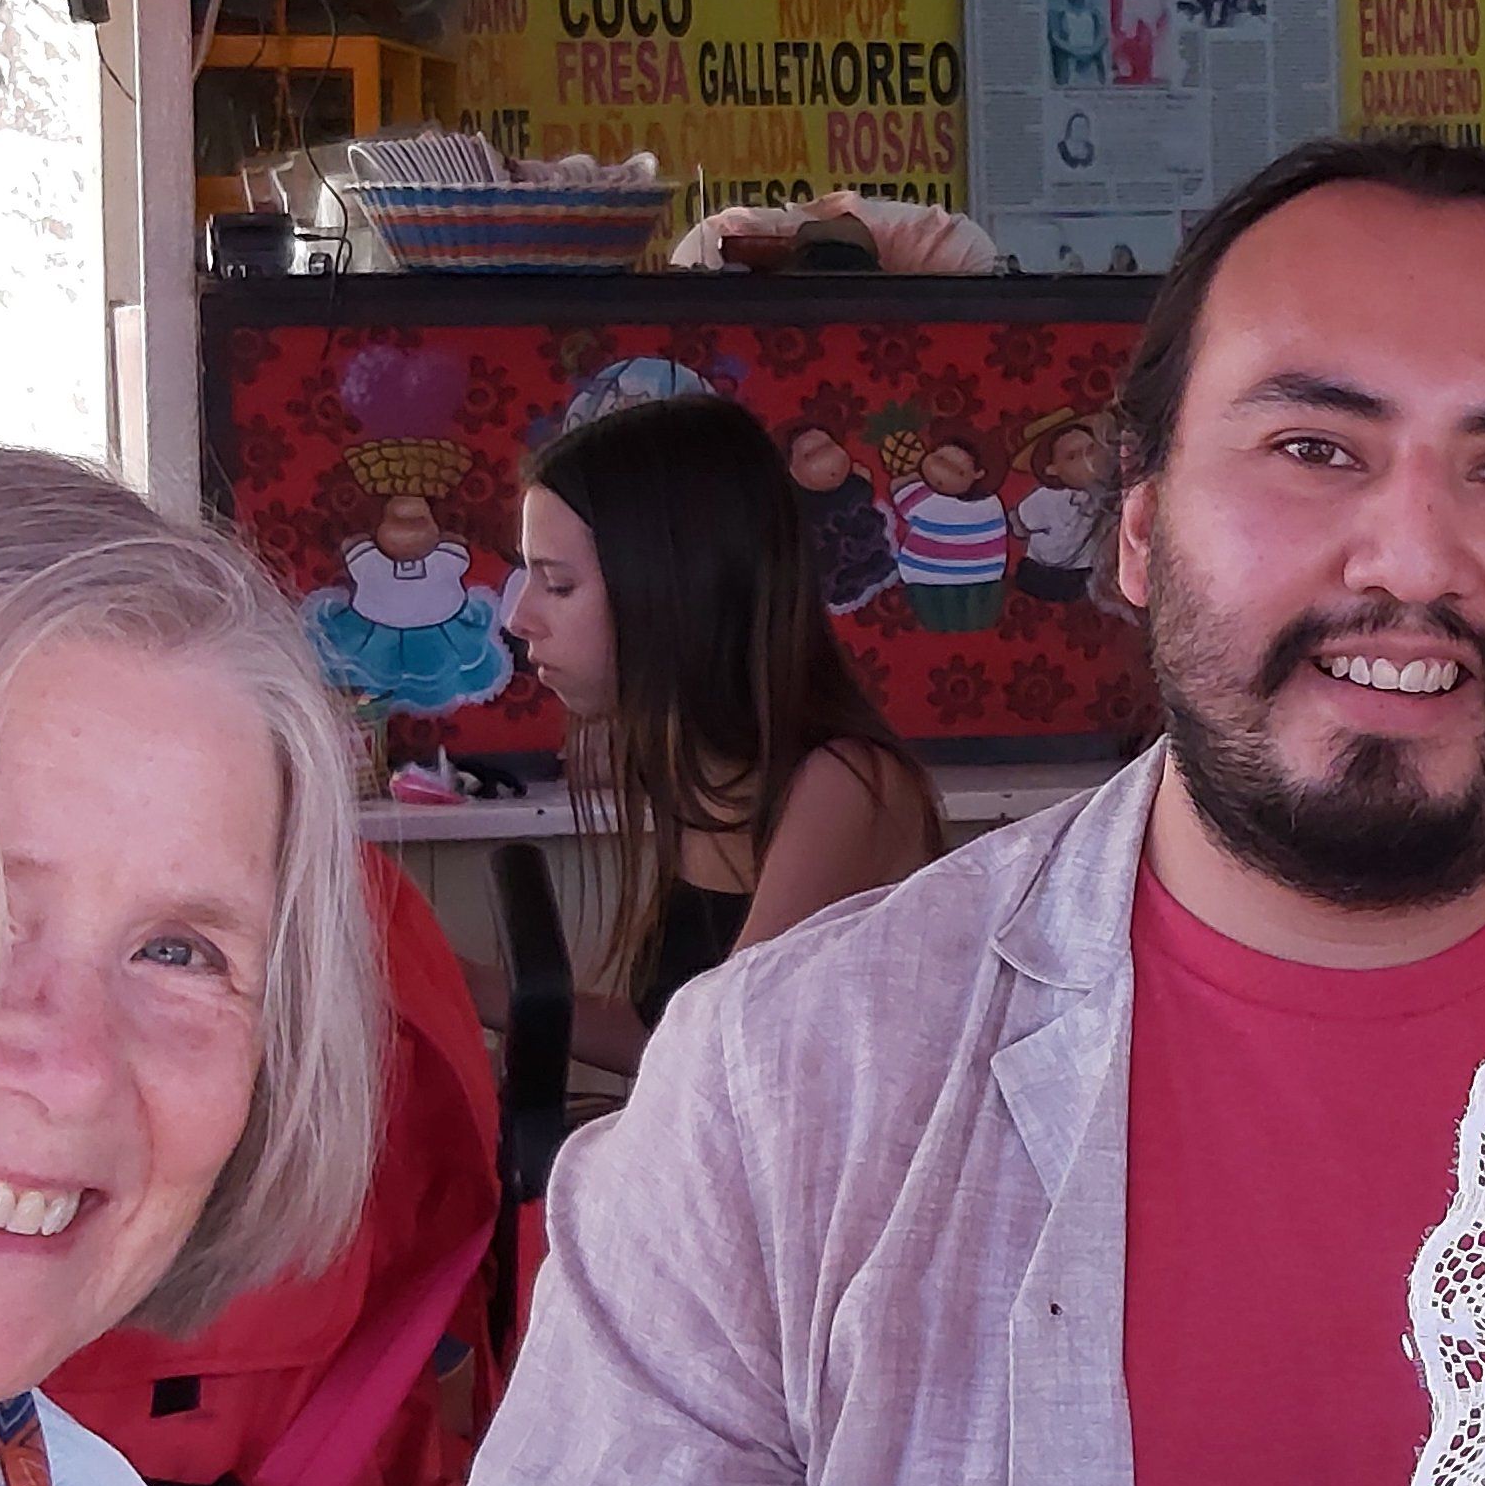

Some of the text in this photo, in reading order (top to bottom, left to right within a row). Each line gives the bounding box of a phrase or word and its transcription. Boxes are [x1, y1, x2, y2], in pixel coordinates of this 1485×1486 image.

[556, 40, 690, 105] FRESA
[699, 41, 961, 106] GALLETA OREO
[827, 111, 956, 175] ROSAS
